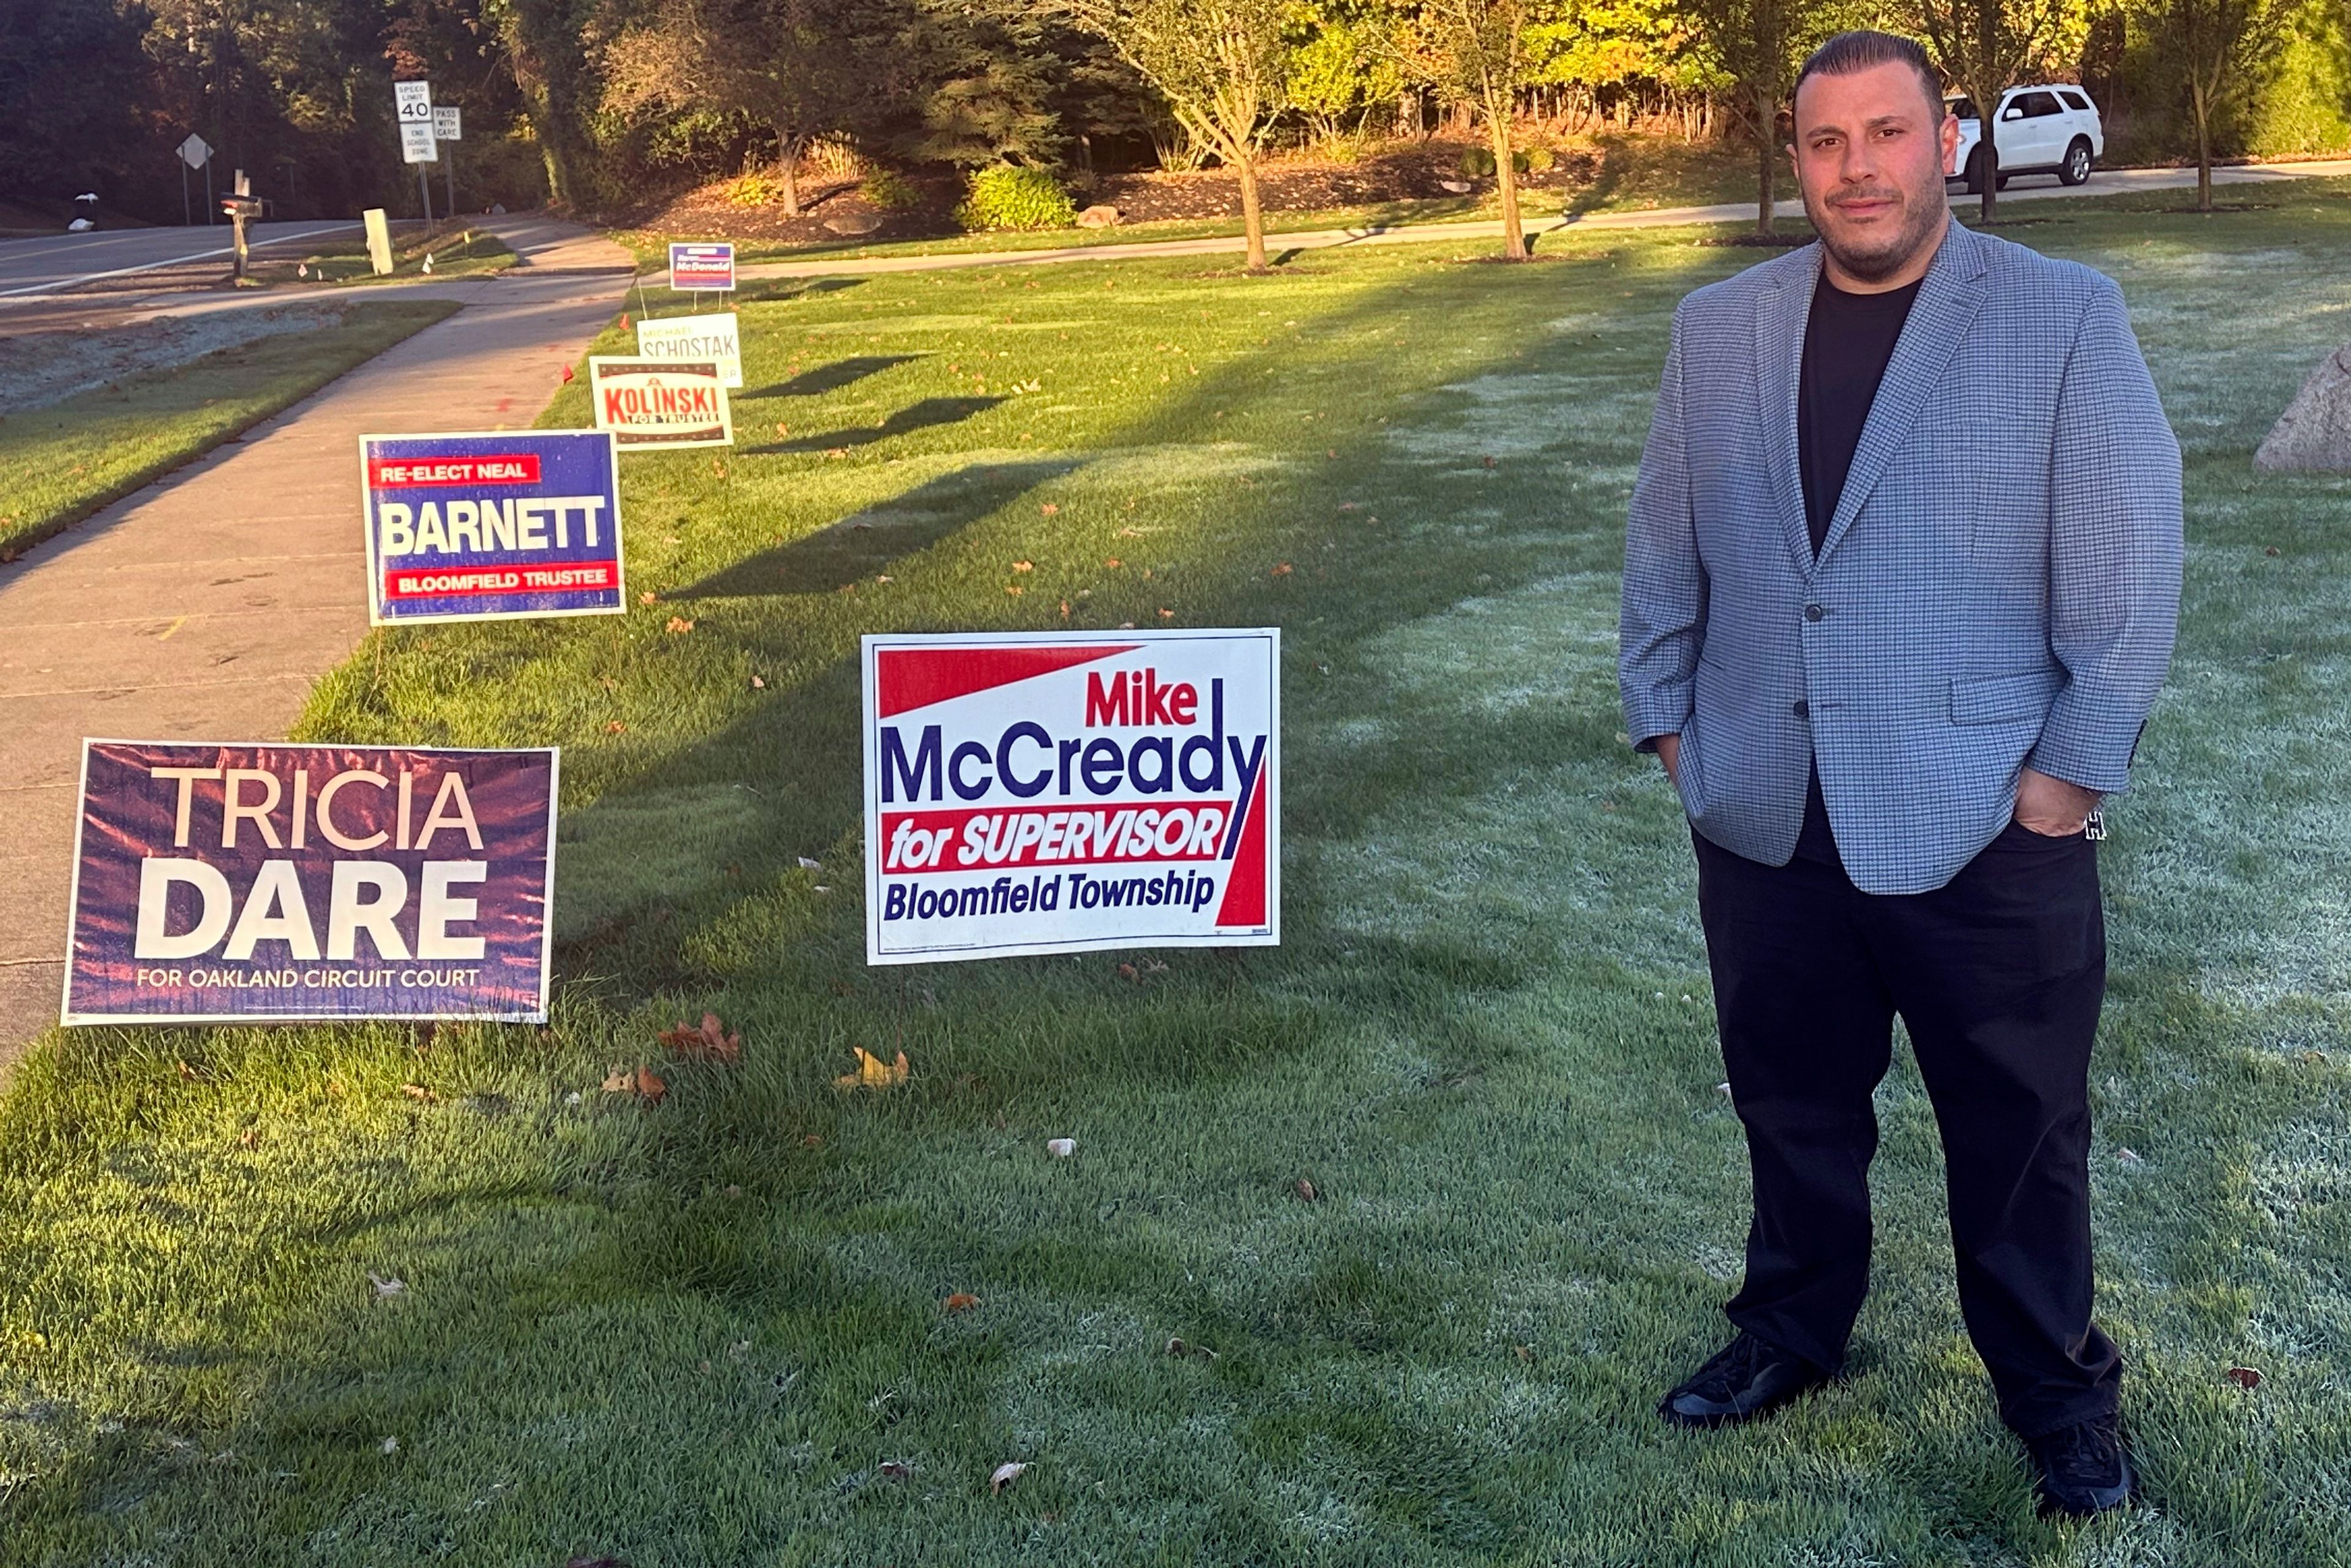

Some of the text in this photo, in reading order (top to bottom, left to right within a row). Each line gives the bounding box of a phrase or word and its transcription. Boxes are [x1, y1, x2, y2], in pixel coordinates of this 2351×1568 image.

[402, 102, 428, 116] 40
[677, 262, 730, 271] McDonald
[643, 326, 692, 337] MICHAEL
[644, 335, 735, 356] SCHOSTAK
[604, 387, 718, 424] KOLINSKI
[631, 415, 657, 424] FOR
[380, 463, 527, 482] RE-ELECT NEAL
[379, 495, 606, 556] BARNETT
[398, 569, 607, 593] BLOOMFIELD TRUSTEE
[1085, 667, 1198, 727] Mike
[880, 678, 1268, 860] McCready
[151, 767, 484, 852] TRICIA
[887, 808, 1225, 869] for SUPERVISOR
[134, 857, 488, 961] DARE
[883, 869, 1215, 921] Bloomfield Township
[137, 969, 481, 988] FOR OAKLAND CIRCUIT COURT
